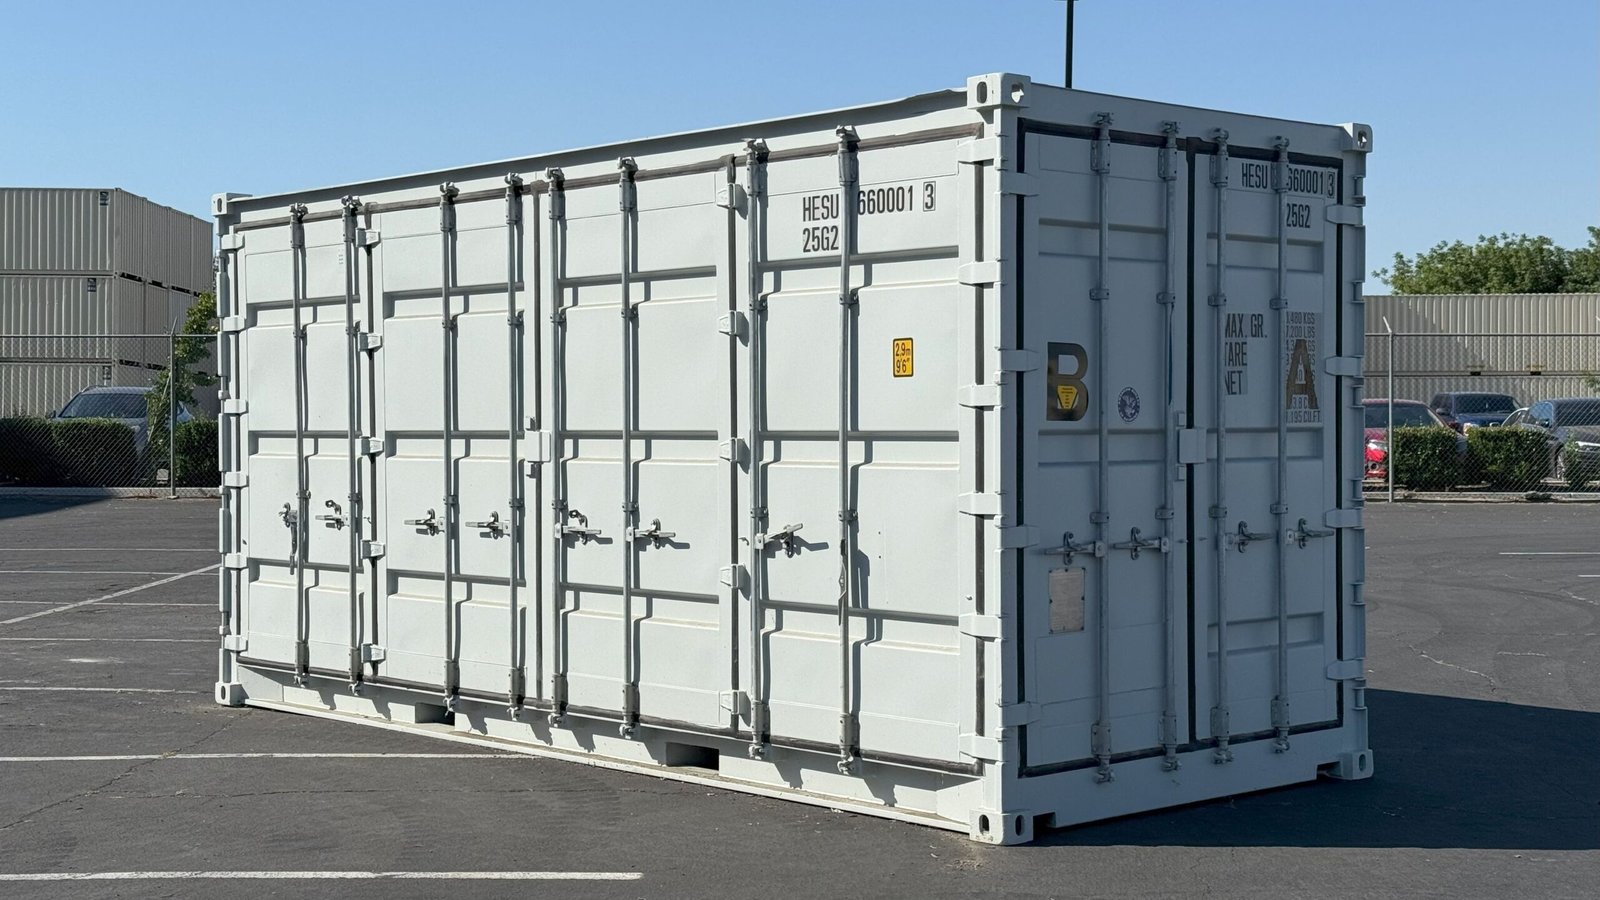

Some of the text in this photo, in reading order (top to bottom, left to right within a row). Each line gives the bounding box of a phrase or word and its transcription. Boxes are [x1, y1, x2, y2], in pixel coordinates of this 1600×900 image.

[1242, 163, 1335, 197] HESU 660001 3
[803, 182, 936, 222] HESU 660001 3
[1286, 203, 1311, 228] 25G2
[803, 225, 839, 253] 25G2
[1250, 313, 1268, 338] GR.
[1046, 342, 1089, 421] B
